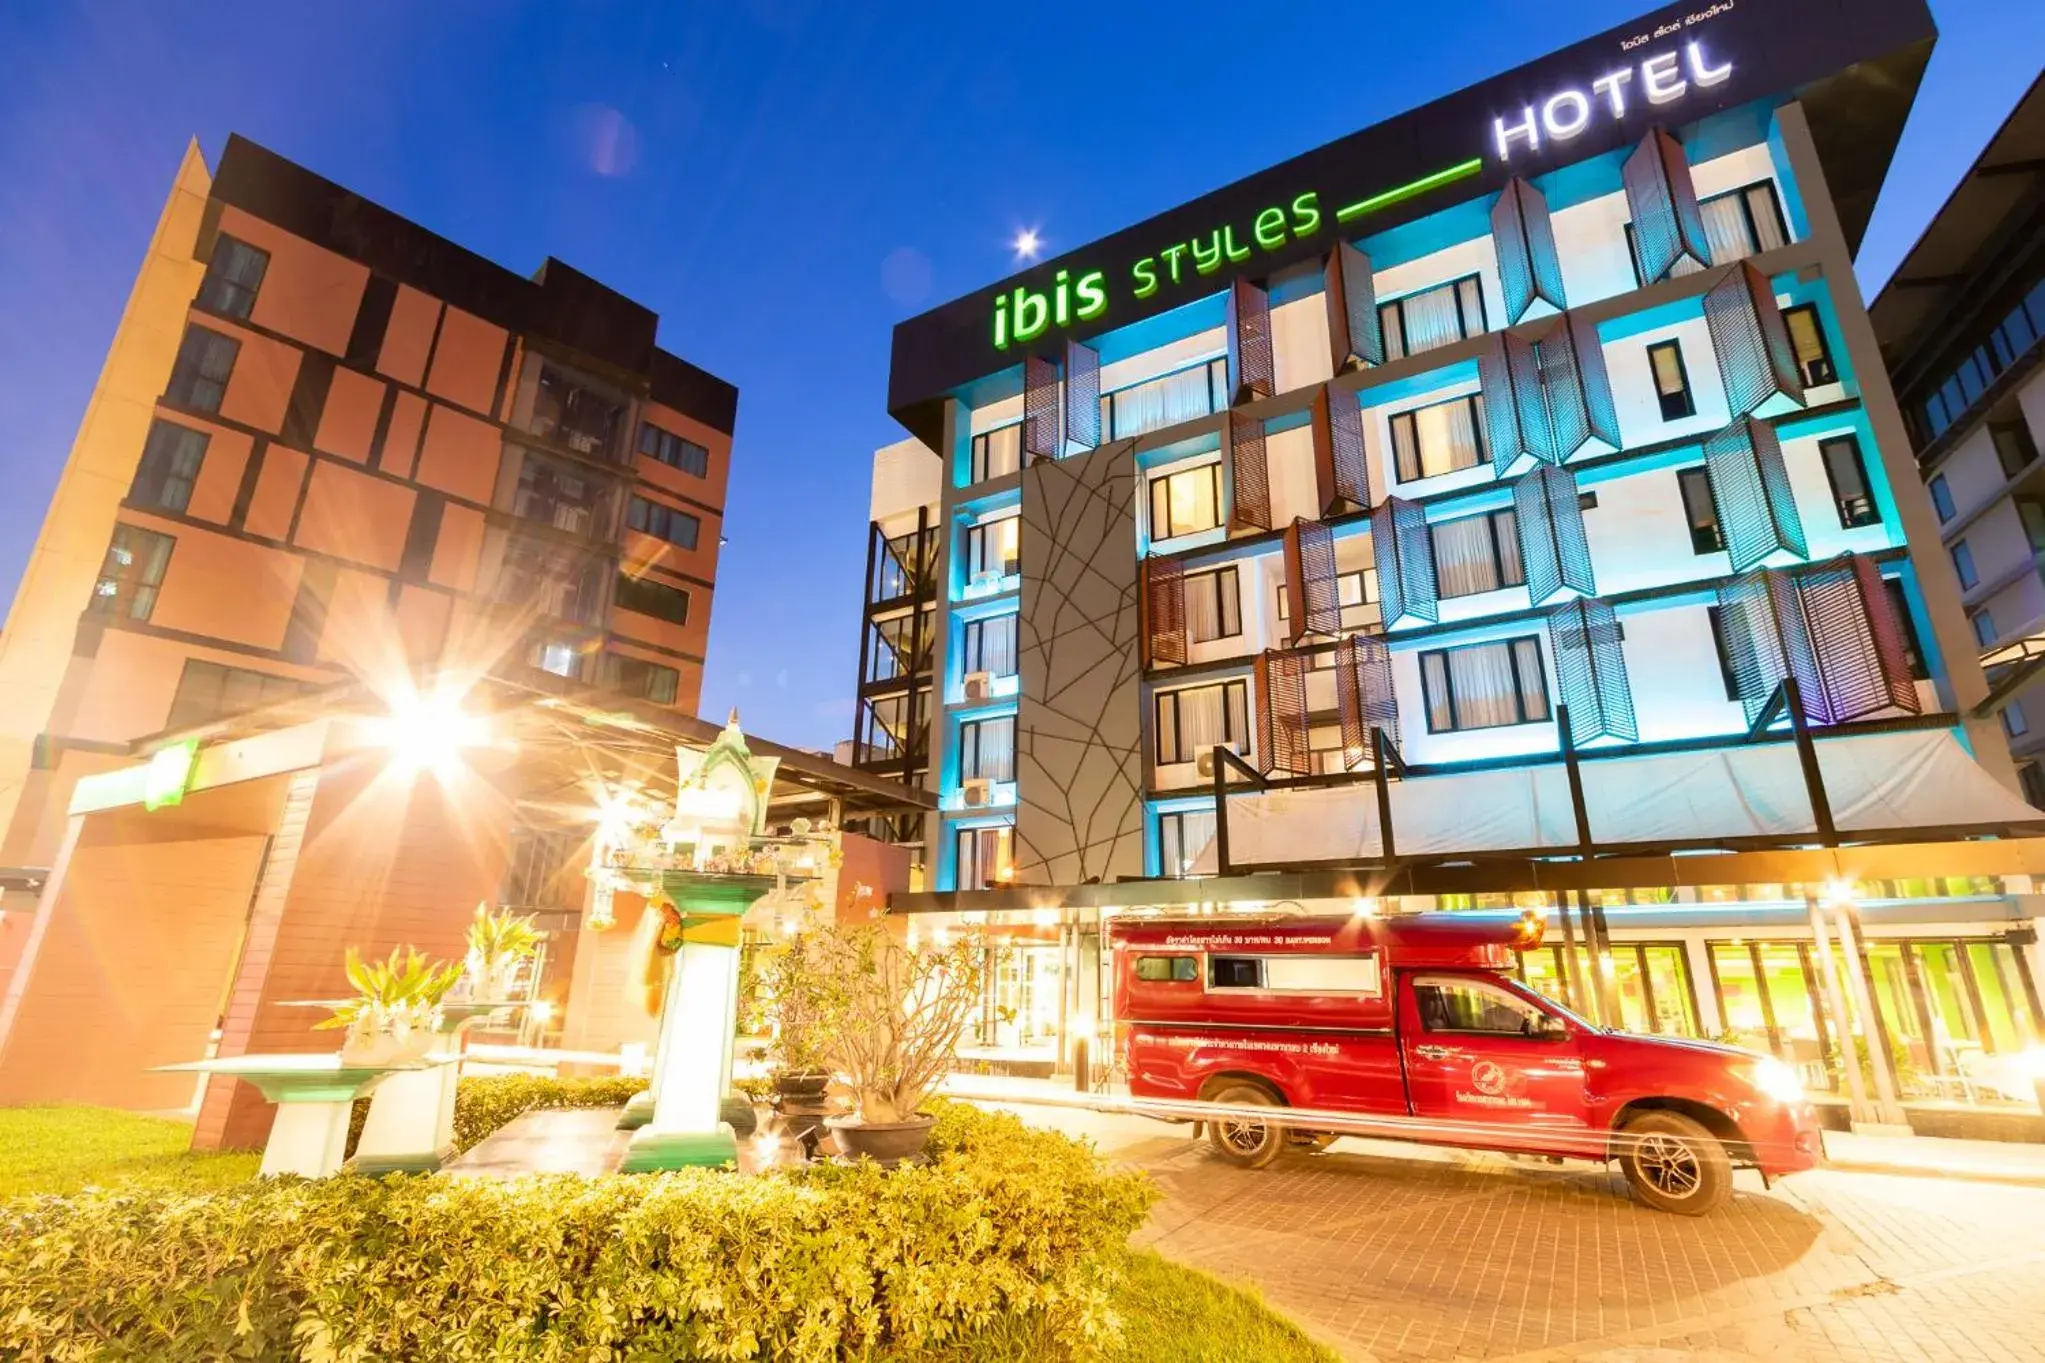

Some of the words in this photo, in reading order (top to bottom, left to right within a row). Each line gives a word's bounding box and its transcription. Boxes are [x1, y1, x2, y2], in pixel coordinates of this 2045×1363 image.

[1620, 33, 1649, 51] ไอบิส
[1494, 40, 1733, 162] HOTEL
[993, 269, 1109, 351] ibis
